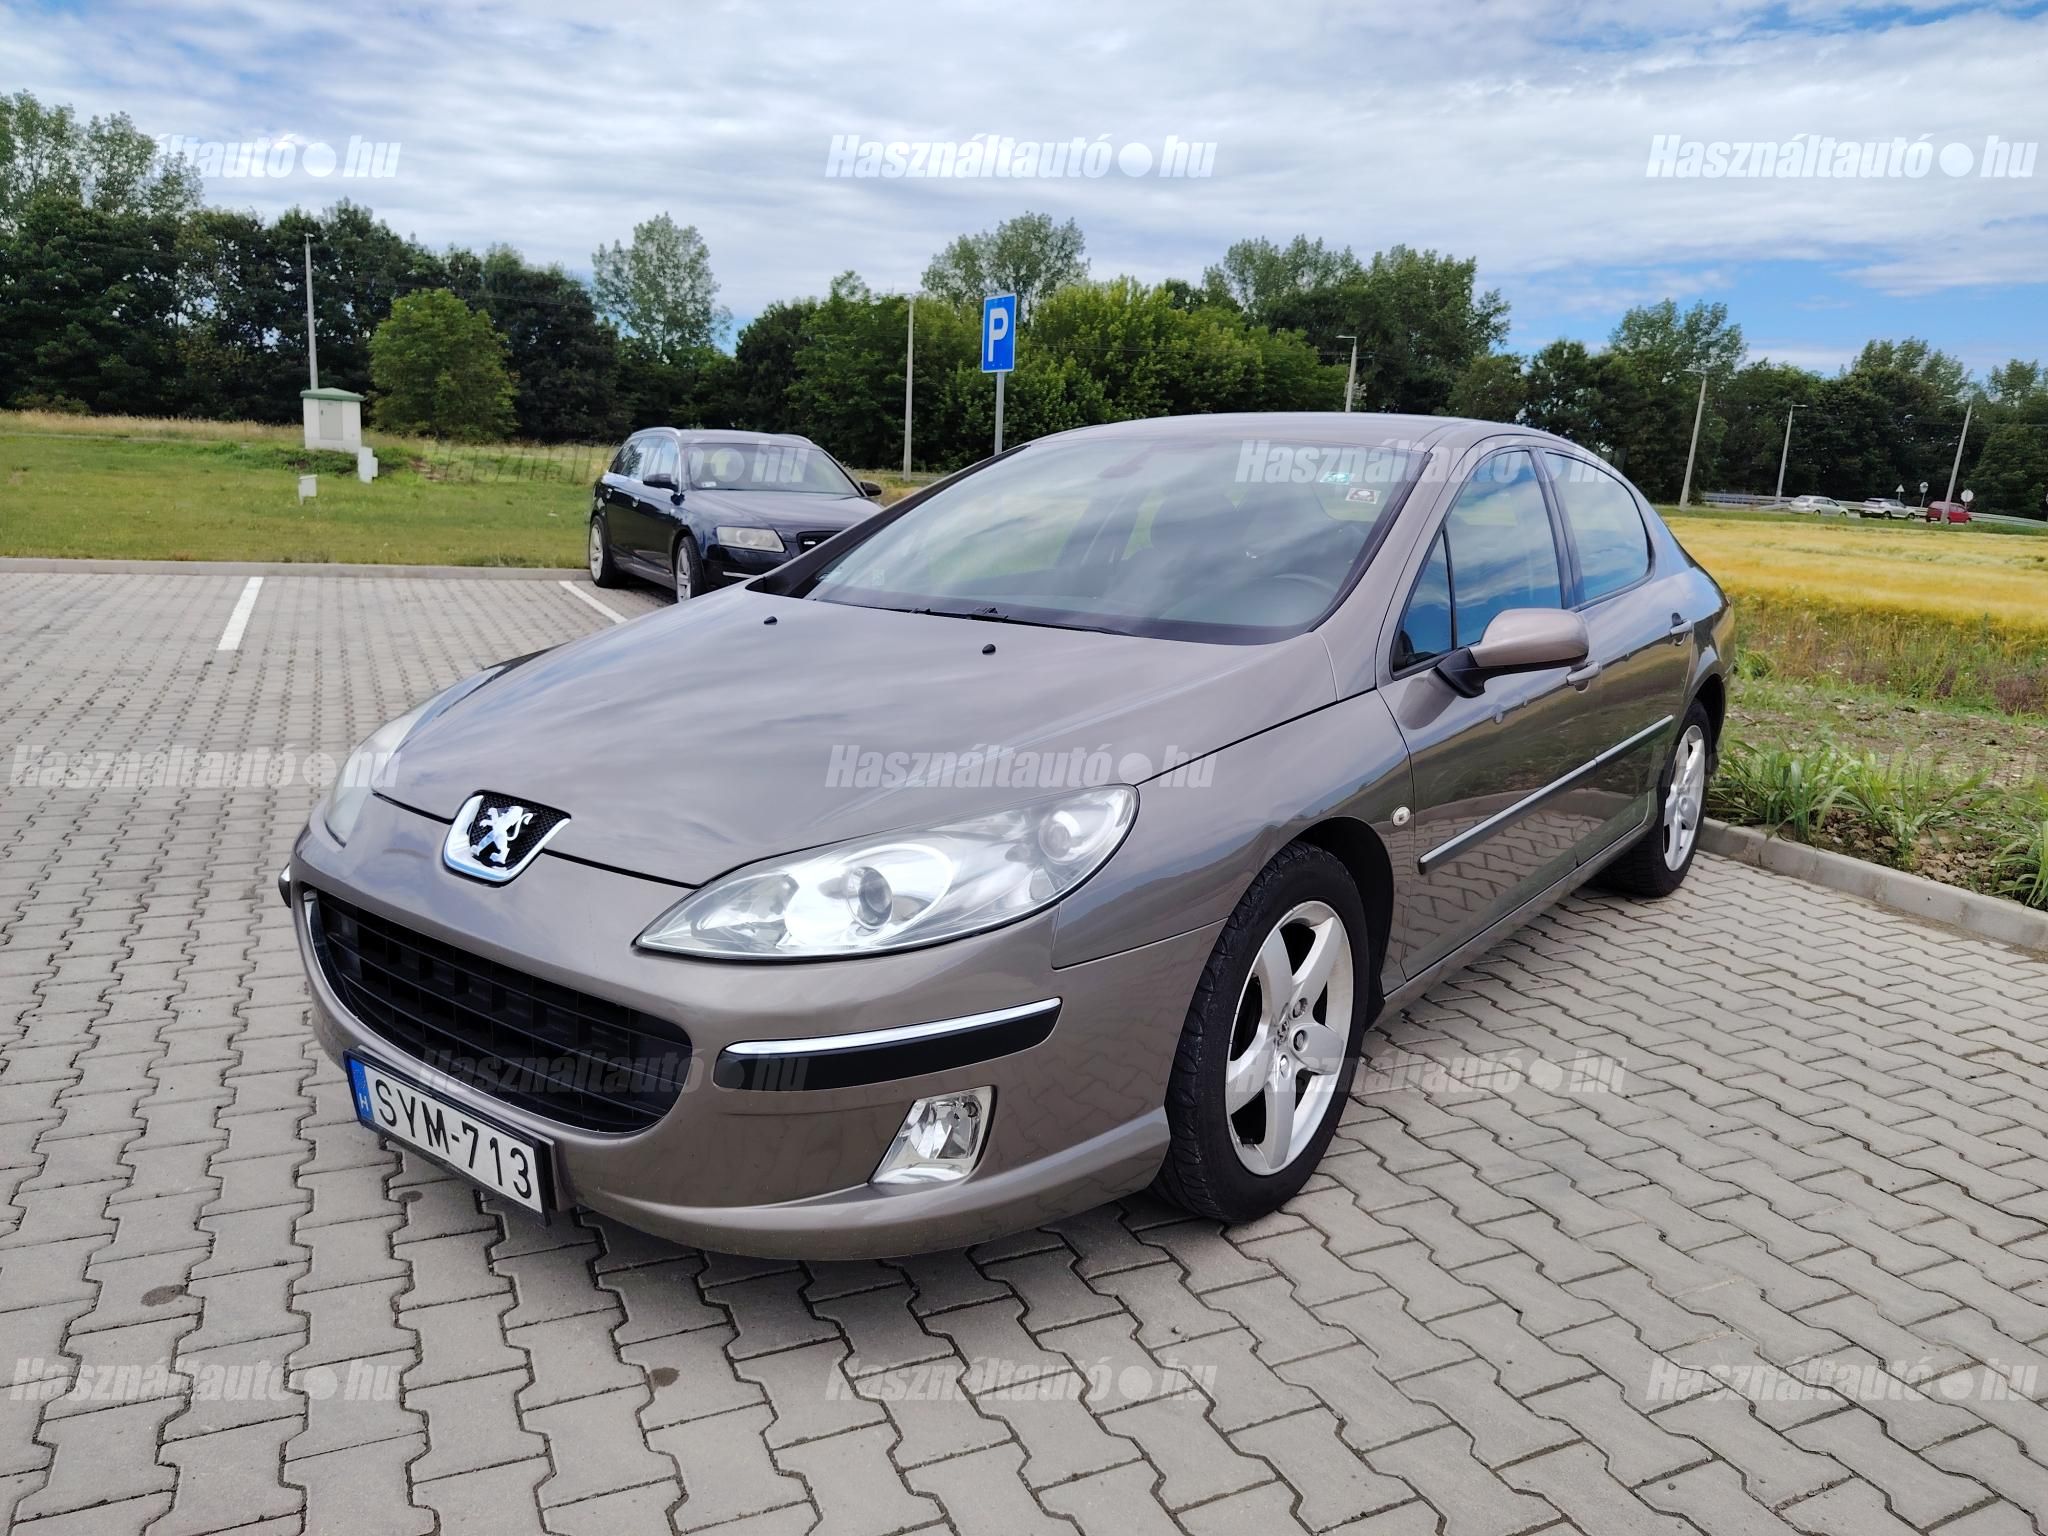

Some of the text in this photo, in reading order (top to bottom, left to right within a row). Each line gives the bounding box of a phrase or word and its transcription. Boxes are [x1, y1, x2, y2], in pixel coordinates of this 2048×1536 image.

[988, 307, 1009, 362] P
[358, 1093, 369, 1112] H
[375, 1079, 532, 1200] SYM-713
